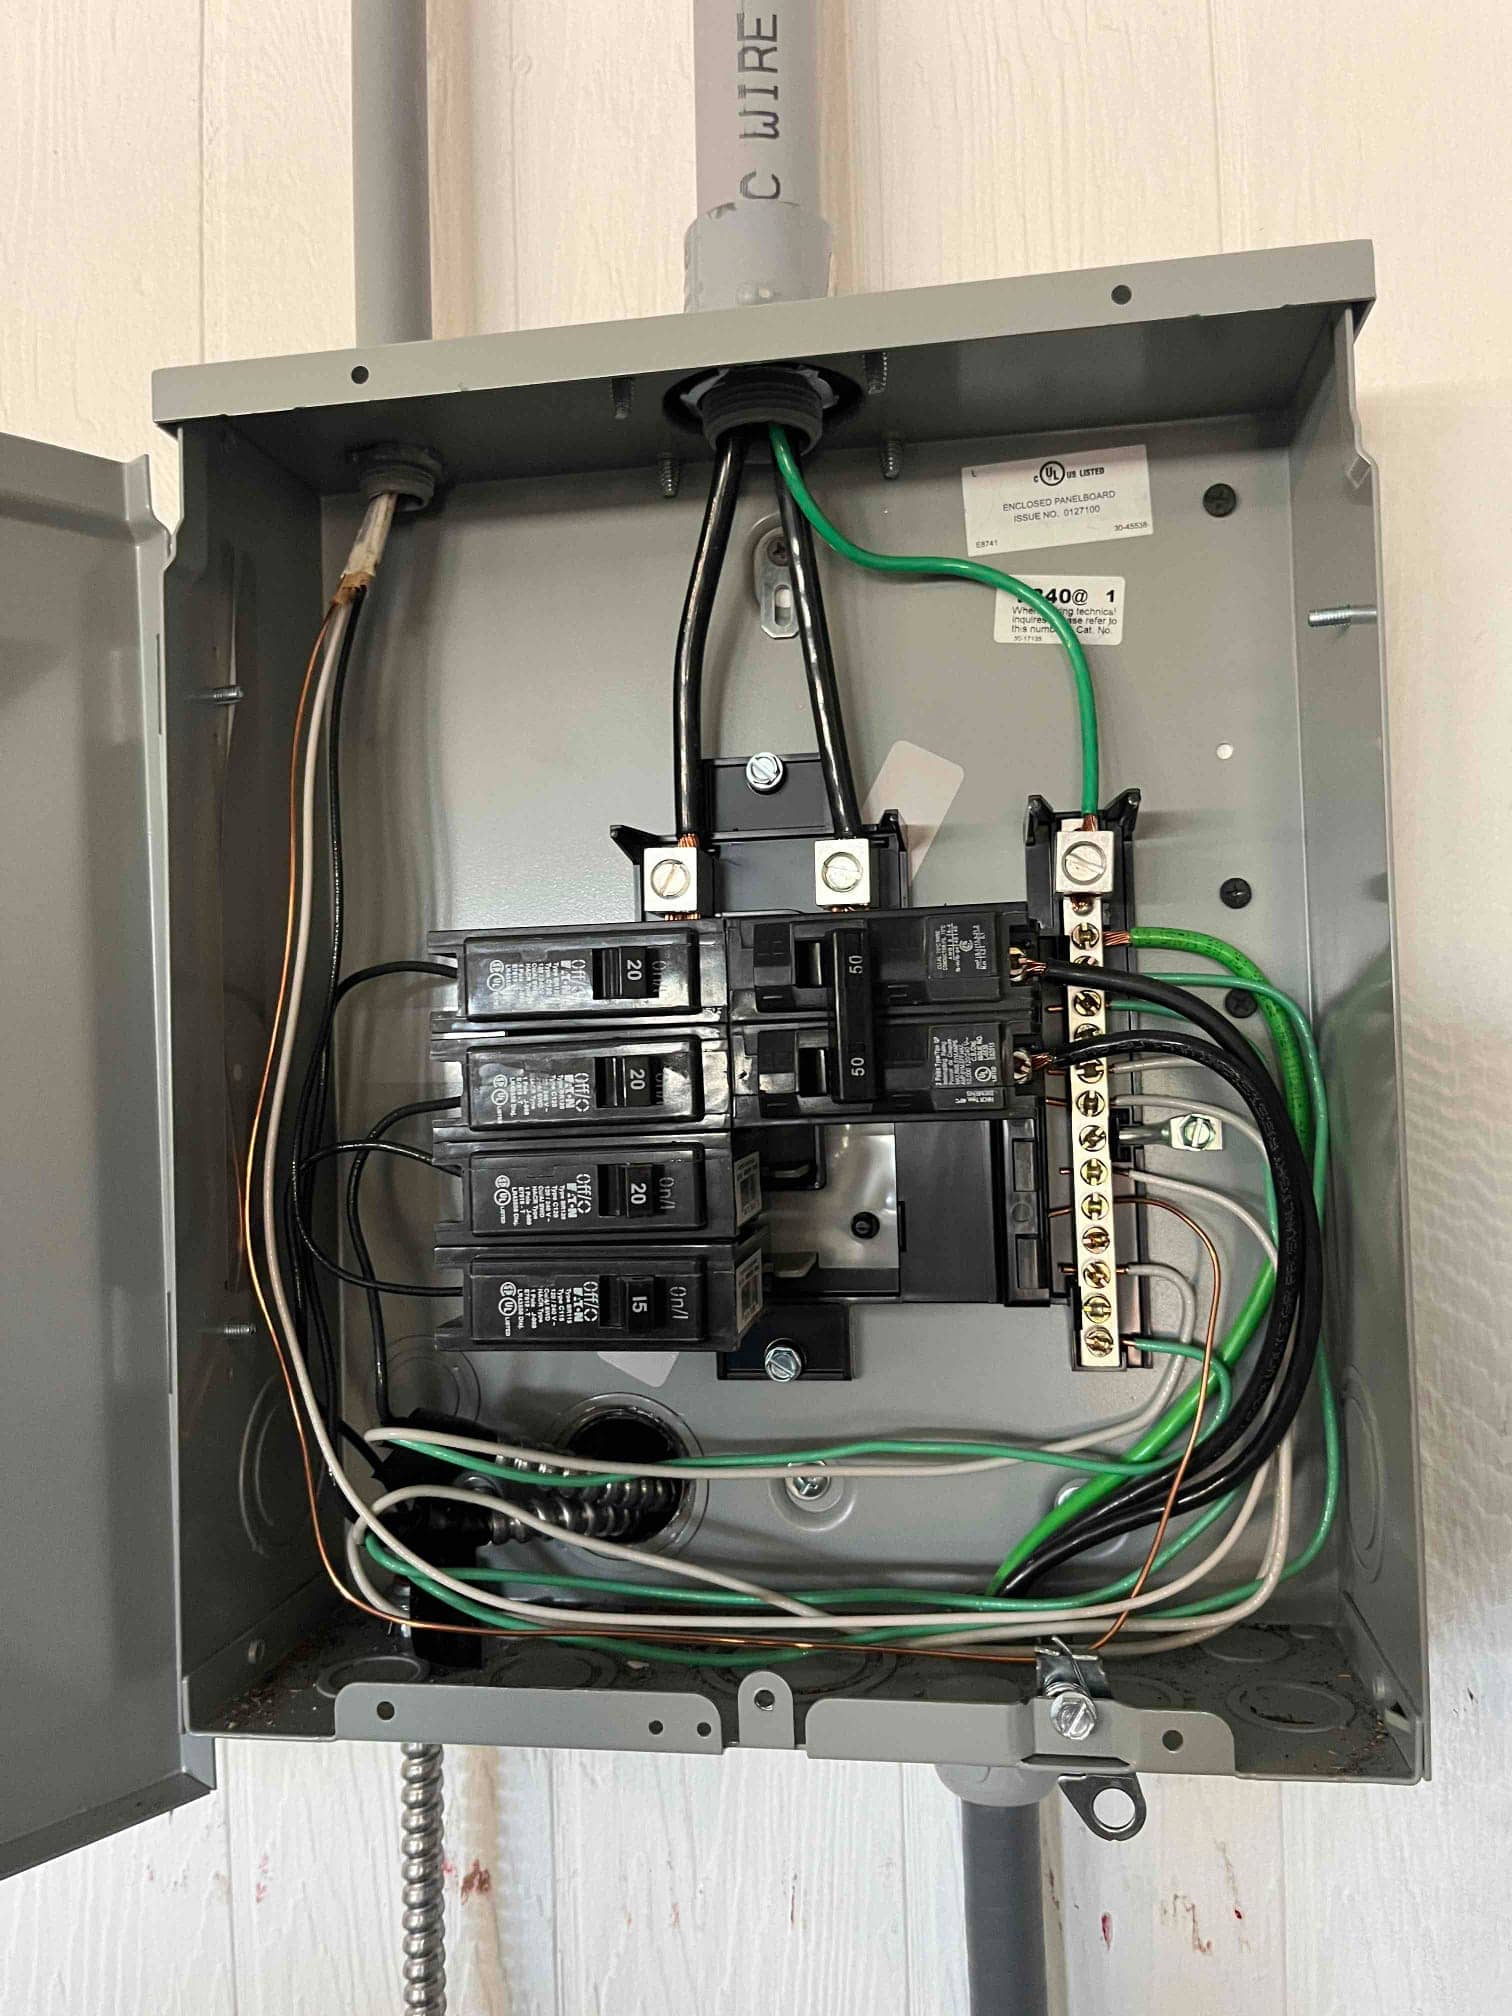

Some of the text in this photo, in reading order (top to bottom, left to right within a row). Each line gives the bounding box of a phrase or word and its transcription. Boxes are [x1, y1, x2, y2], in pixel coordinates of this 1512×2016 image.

[736, 13, 781, 200] C WIRE
[1079, 466, 1105, 477] LISTED
[1003, 490, 1116, 512] ENCLOSED PANELBOARD
[1014, 512, 1041, 523] ISSUE
[1043, 510, 1060, 520] NO.
[1106, 589, 1115, 603] 1
[1085, 616, 1106, 625] refer
[627, 960, 642, 980] 20
[849, 954, 863, 975] 50
[851, 1056, 865, 1077] 50
[631, 1070, 645, 1090] 20
[631, 1183, 646, 1204] 20
[632, 1296, 648, 1313] 15
